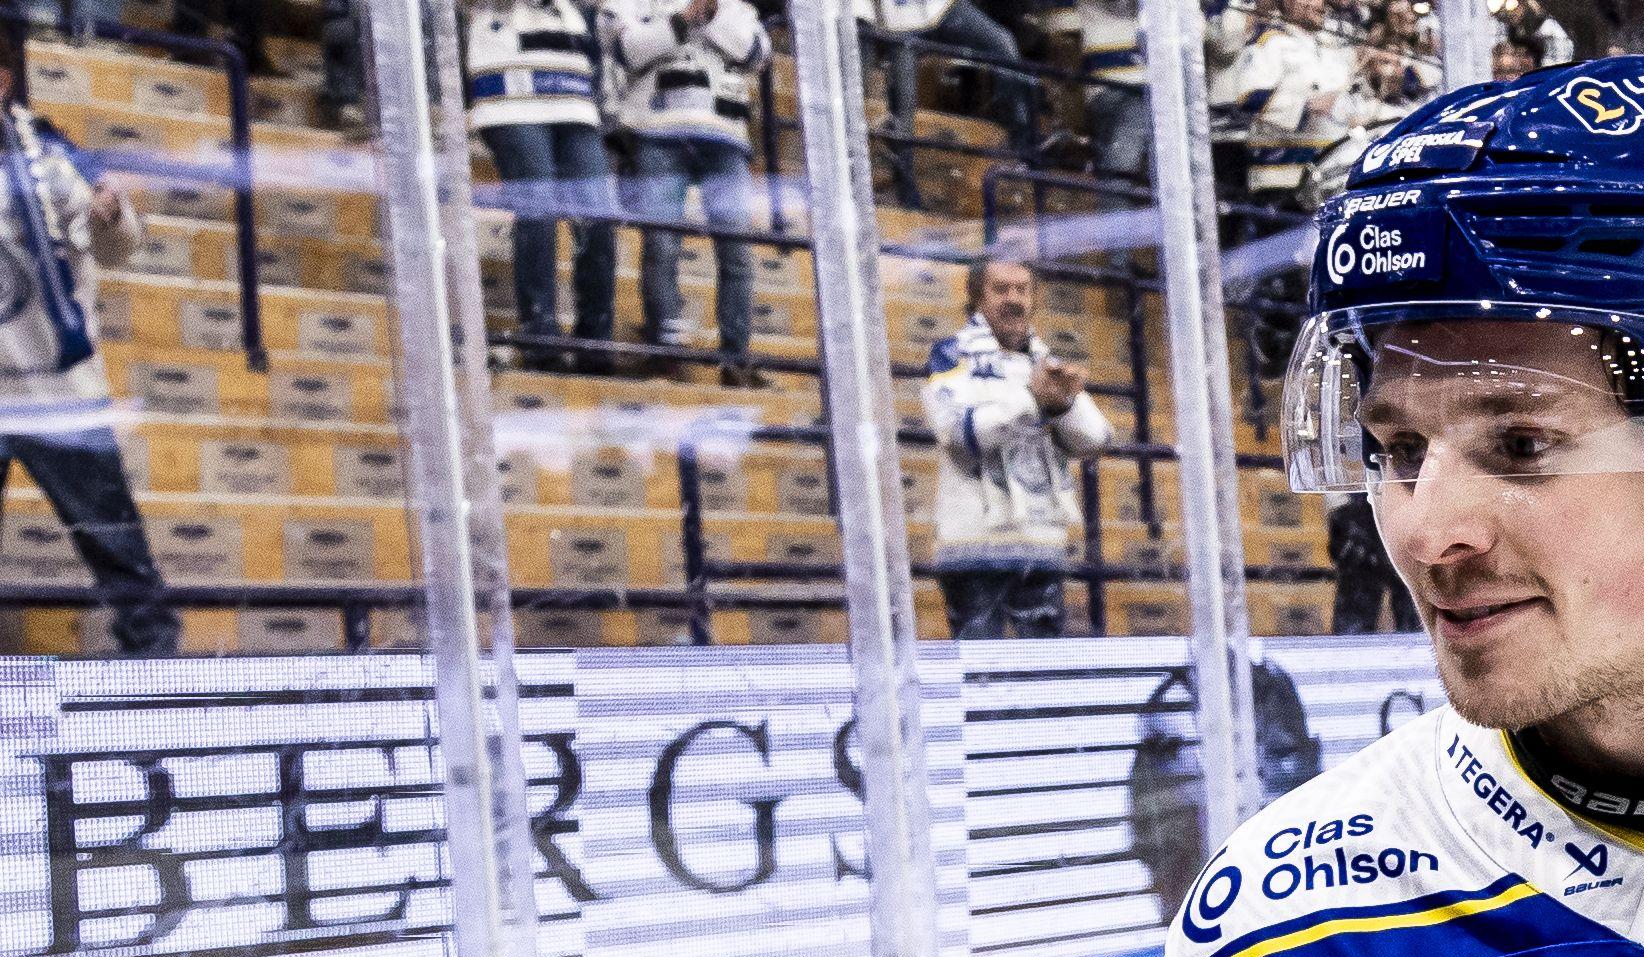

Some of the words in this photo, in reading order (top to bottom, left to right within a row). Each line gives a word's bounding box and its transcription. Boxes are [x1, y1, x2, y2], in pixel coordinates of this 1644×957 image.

[1360, 225, 1402, 250] Clas
[1361, 251, 1426, 275] Ohlson
[14, 714, 870, 957] BERG
[1264, 813, 1375, 860] Clas
[1261, 846, 1439, 900] Ohlson
[1563, 876, 1624, 897] BAUER
